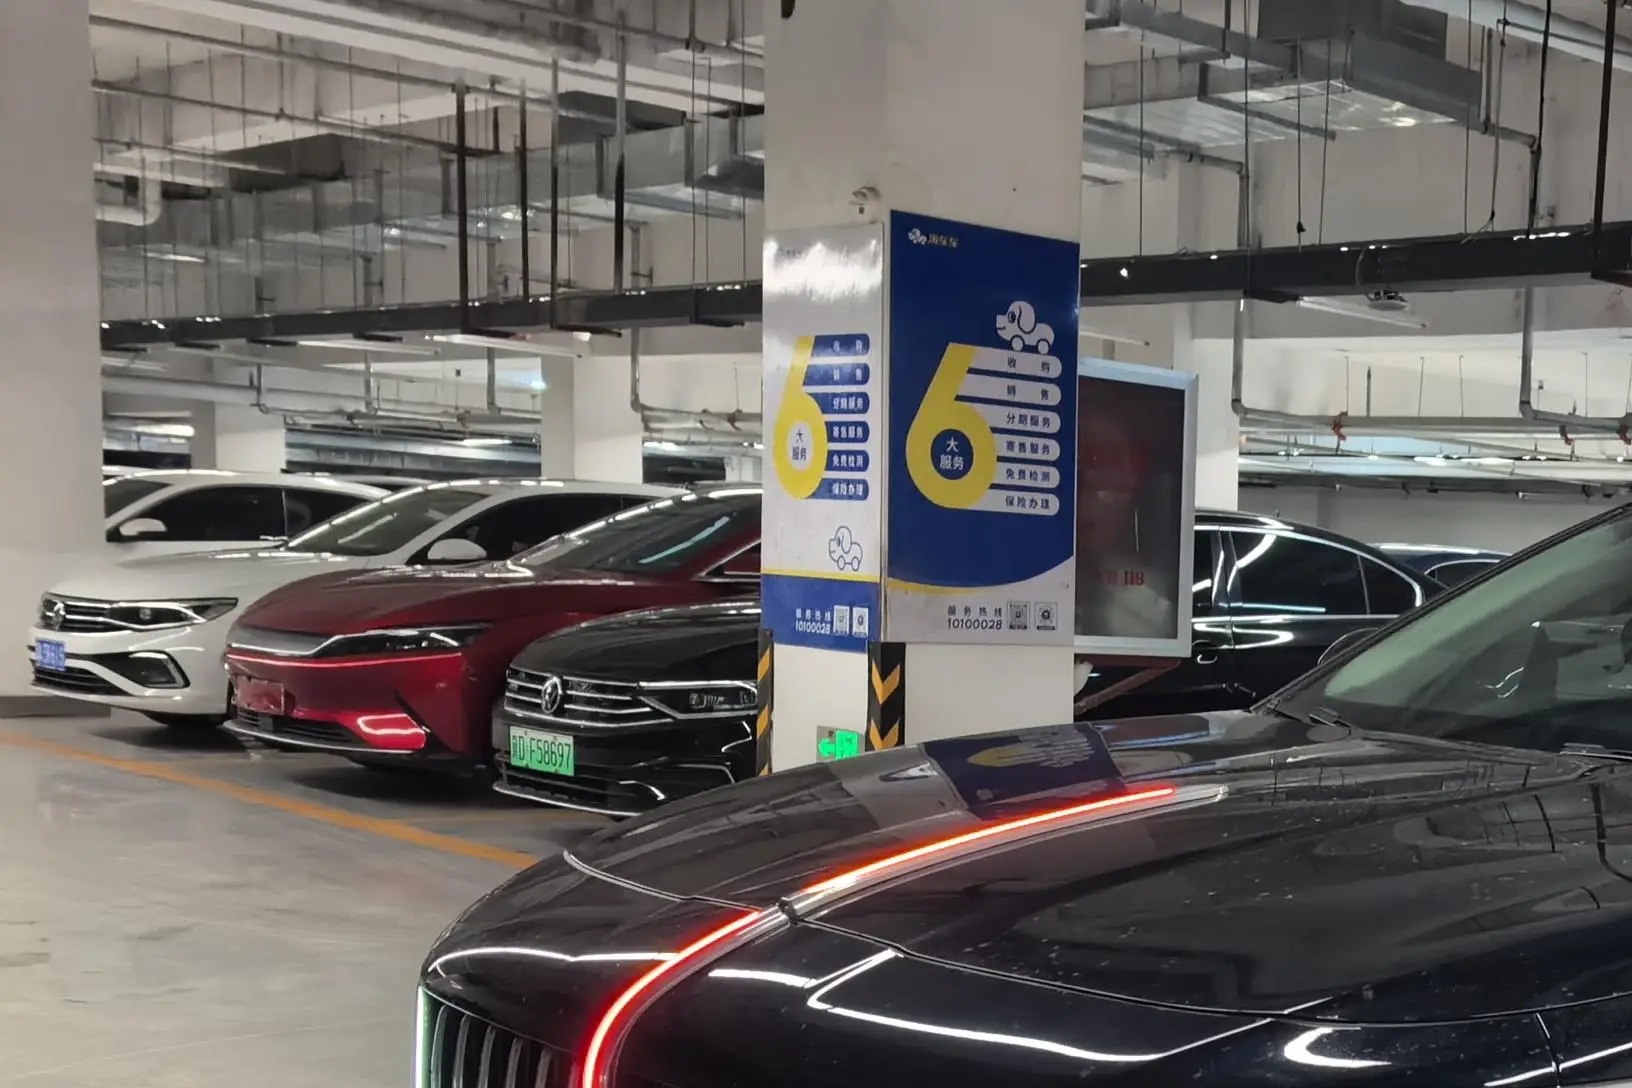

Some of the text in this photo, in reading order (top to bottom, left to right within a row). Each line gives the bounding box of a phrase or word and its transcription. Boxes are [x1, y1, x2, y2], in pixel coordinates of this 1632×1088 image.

[1006, 413, 1050, 429] 分期服务
[946, 436, 959, 453] 大
[940, 454, 964, 471] 服务
[1005, 468, 1050, 483] 免费检测
[1005, 495, 1050, 511] 保险办理
[795, 619, 831, 635] 10100028
[947, 618, 1003, 630] 10100028
